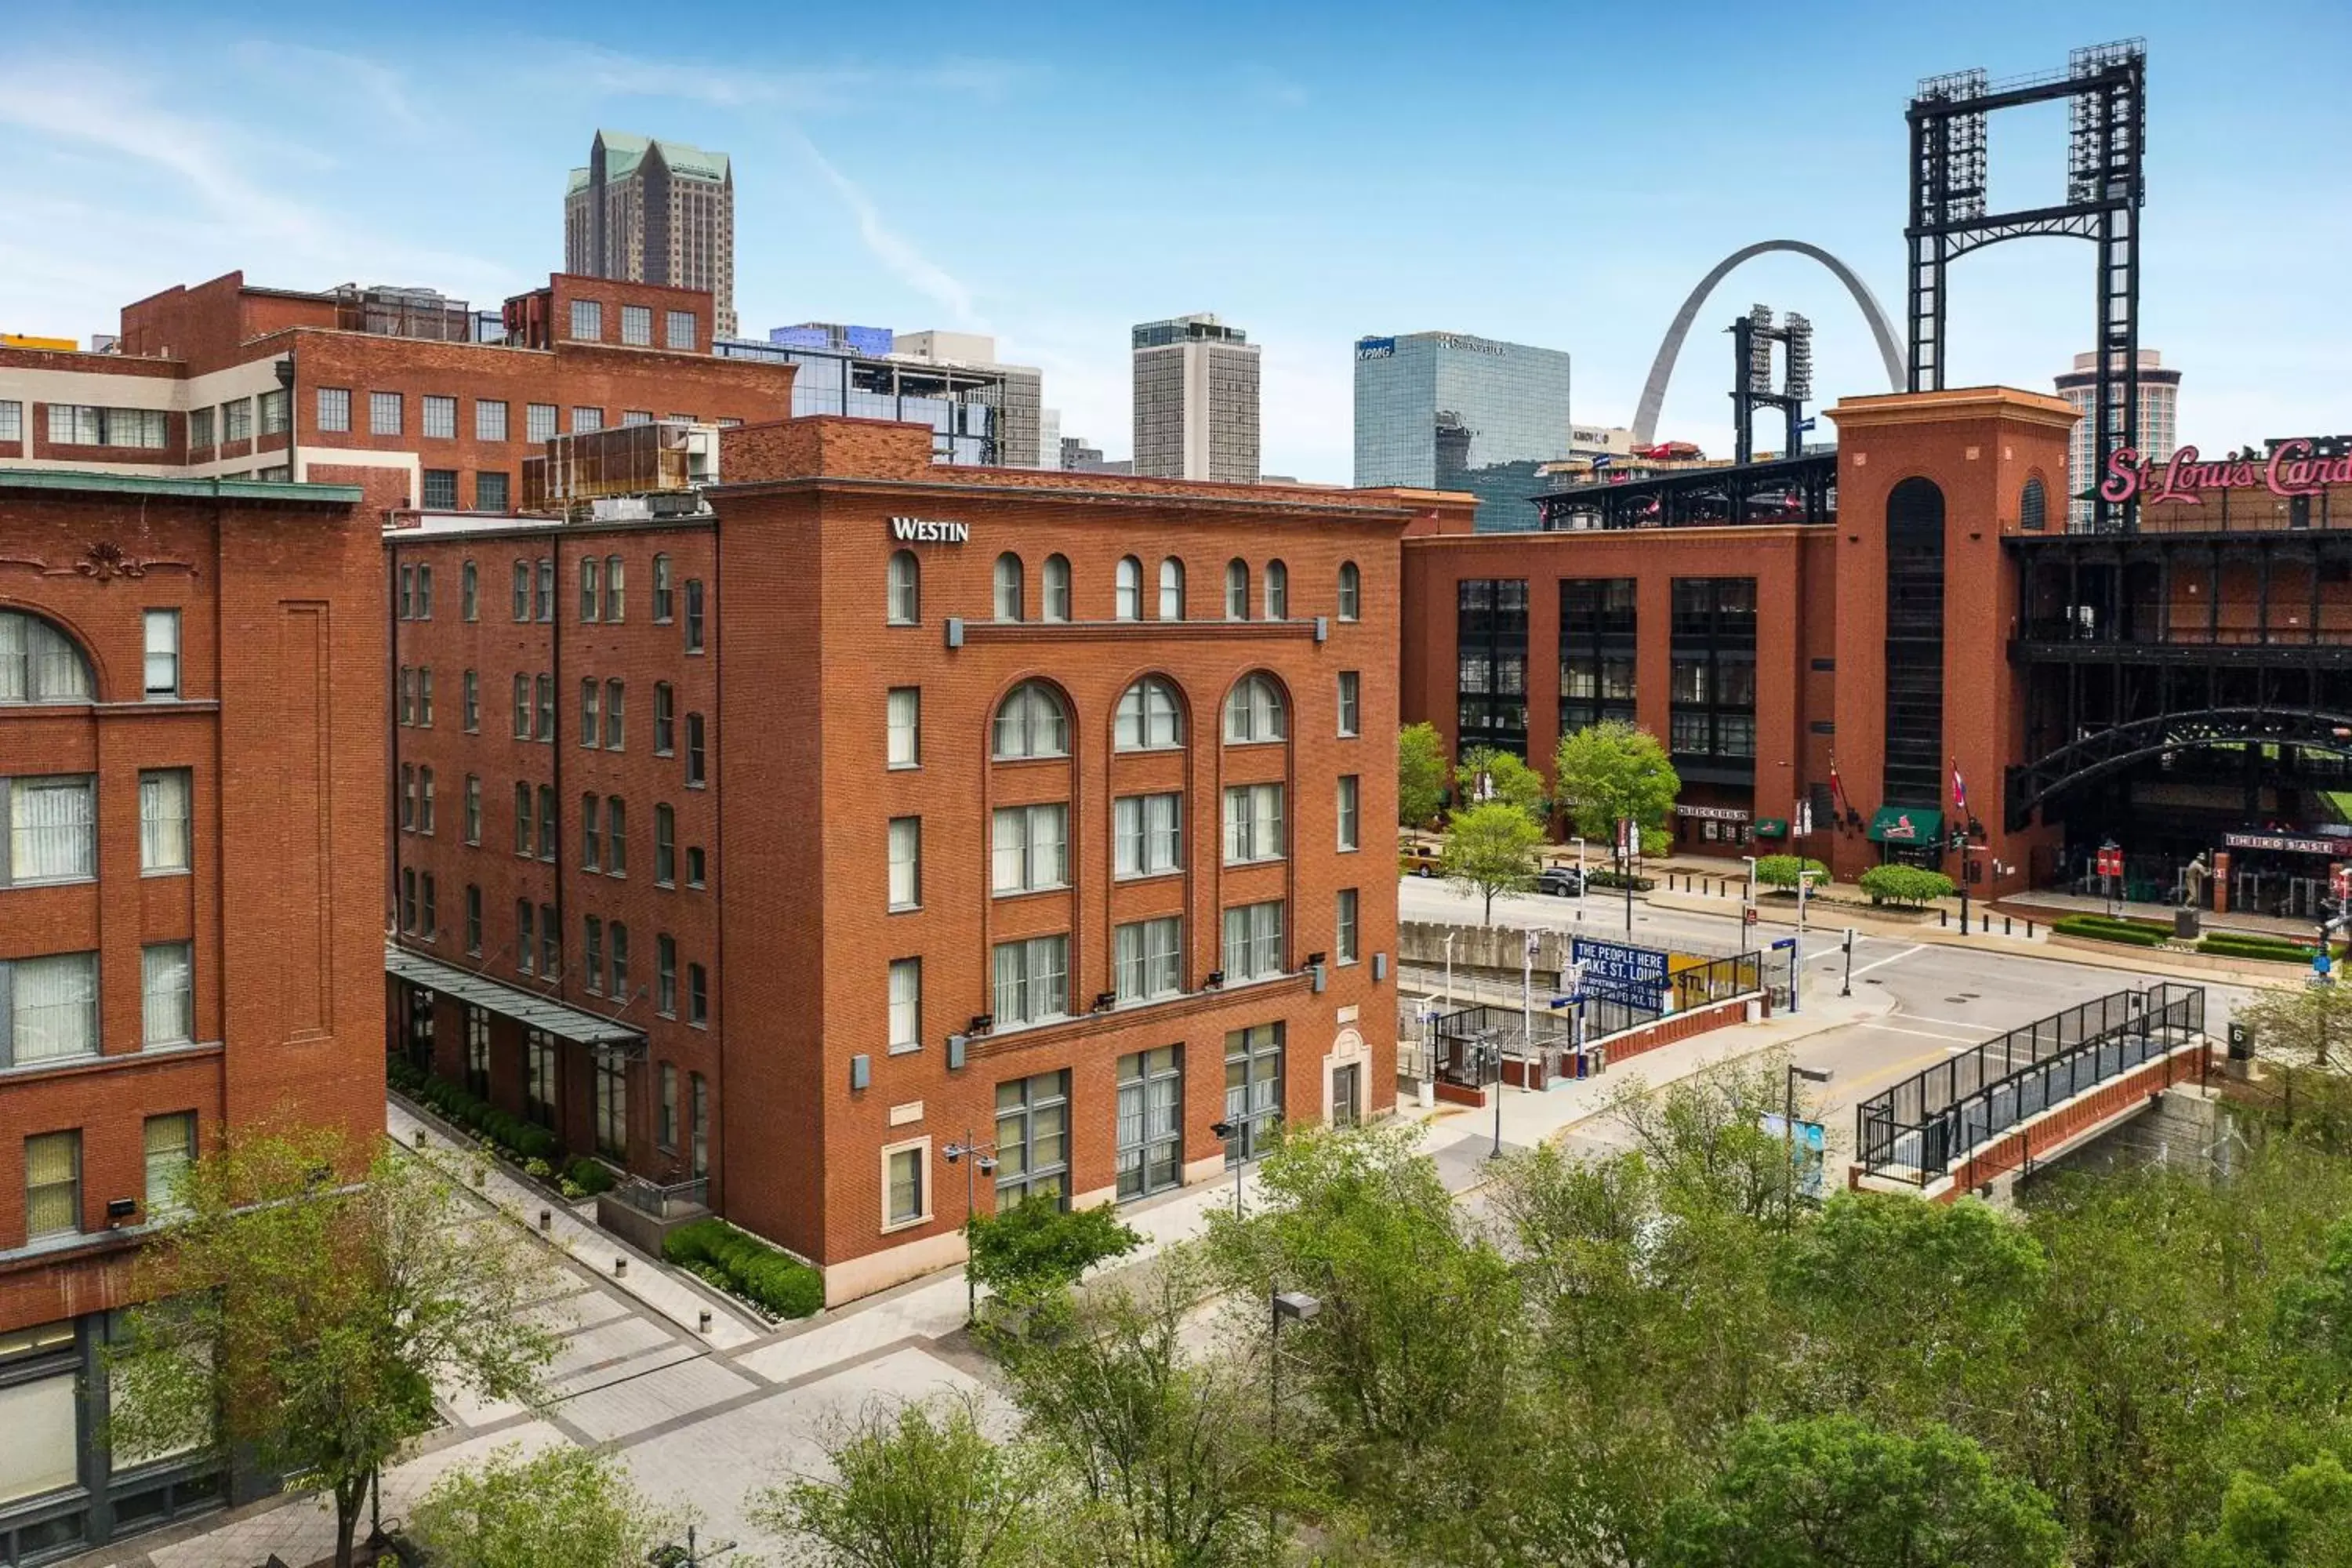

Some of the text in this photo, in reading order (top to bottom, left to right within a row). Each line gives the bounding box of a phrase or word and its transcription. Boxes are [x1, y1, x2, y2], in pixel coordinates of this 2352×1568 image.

[1356, 346, 1390, 361] KPMG
[2100, 446, 2158, 503] St.
[2150, 445, 2256, 506] Louis
[891, 517, 970, 542] WESTIN
[2227, 835, 2332, 854] THIRD BASE
[1577, 943, 1663, 970] THE PEOPLE HERE
[1610, 962, 1627, 979] ST.
